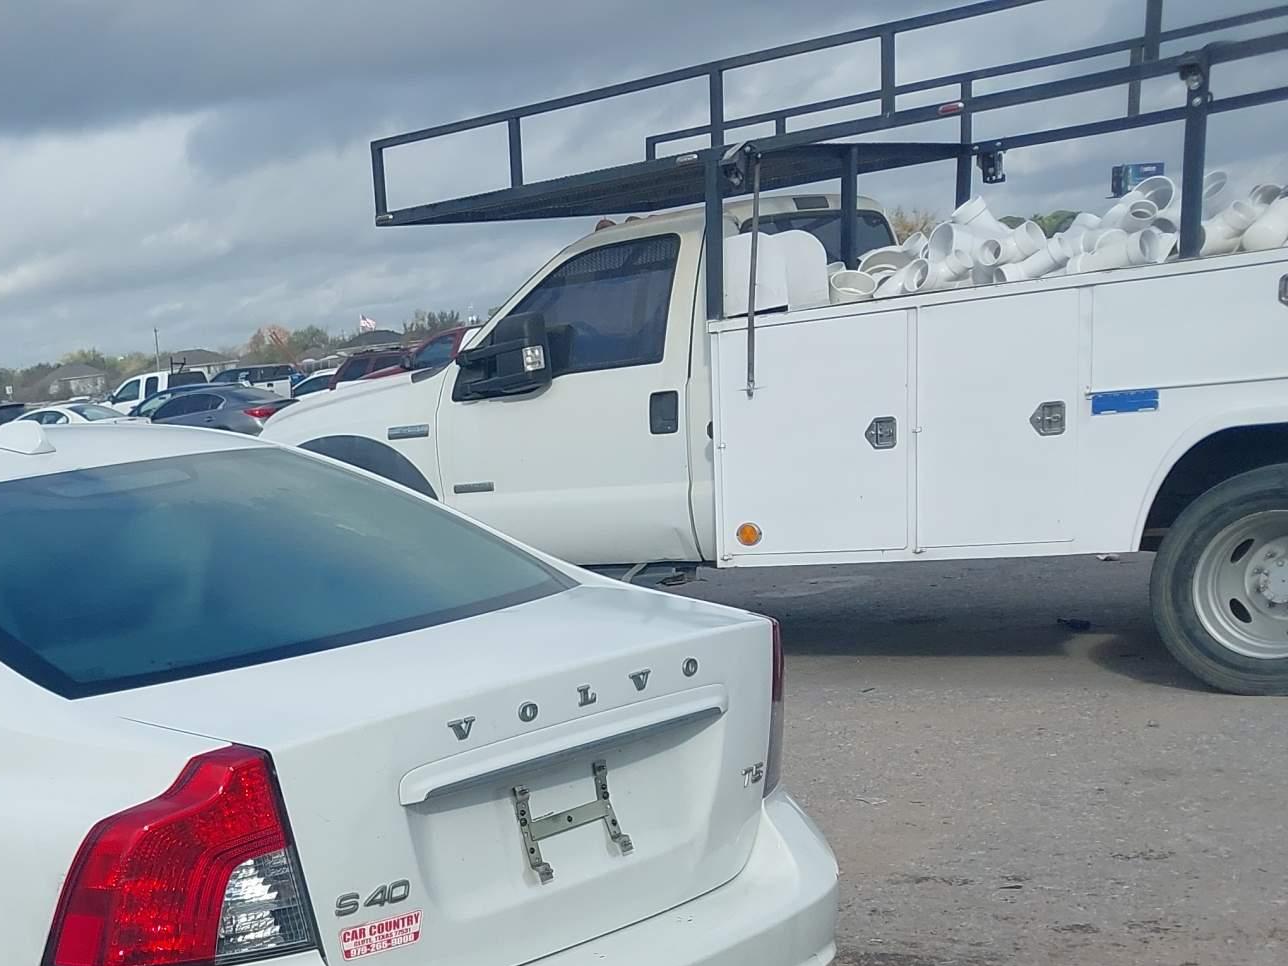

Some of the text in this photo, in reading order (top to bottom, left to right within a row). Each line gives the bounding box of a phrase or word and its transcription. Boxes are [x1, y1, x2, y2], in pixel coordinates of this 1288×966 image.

[447, 657, 699, 741] VOLVO
[742, 761, 763, 788] T5
[343, 912, 420, 943] CAR COUNTRY
